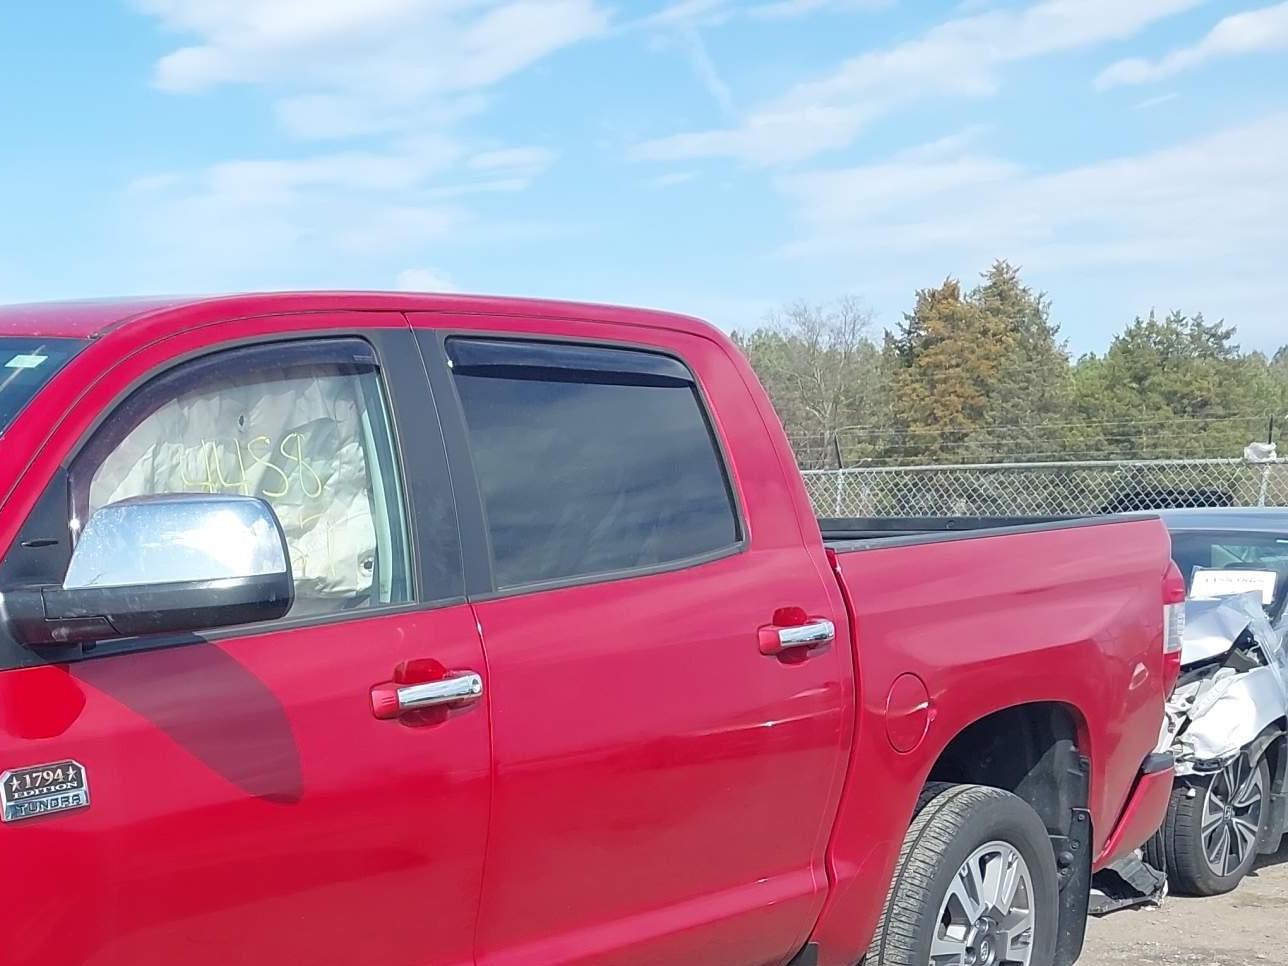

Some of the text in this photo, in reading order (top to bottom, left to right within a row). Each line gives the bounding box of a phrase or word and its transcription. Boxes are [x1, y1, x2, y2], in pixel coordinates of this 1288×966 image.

[23, 768, 64, 789] 1794
[12, 781, 78, 799] EDITION
[16, 793, 81, 816] TUNDRA
